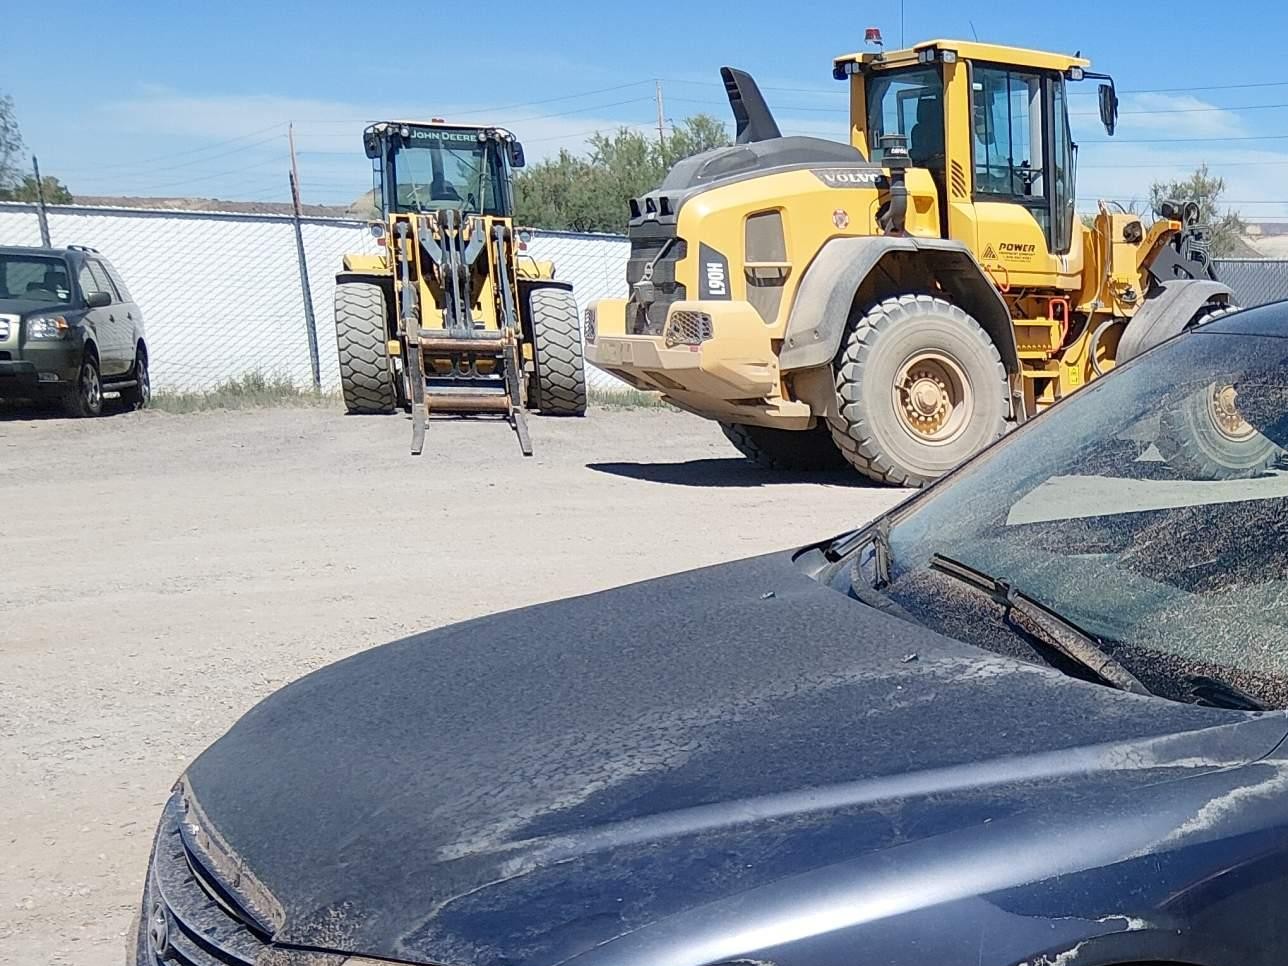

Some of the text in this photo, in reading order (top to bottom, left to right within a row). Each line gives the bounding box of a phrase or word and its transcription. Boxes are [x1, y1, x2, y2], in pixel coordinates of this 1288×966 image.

[410, 129, 478, 142] JOHN DEERE
[824, 173, 881, 182] VOLVO
[998, 242, 1036, 252] POWER
[707, 263, 726, 295] L90H
